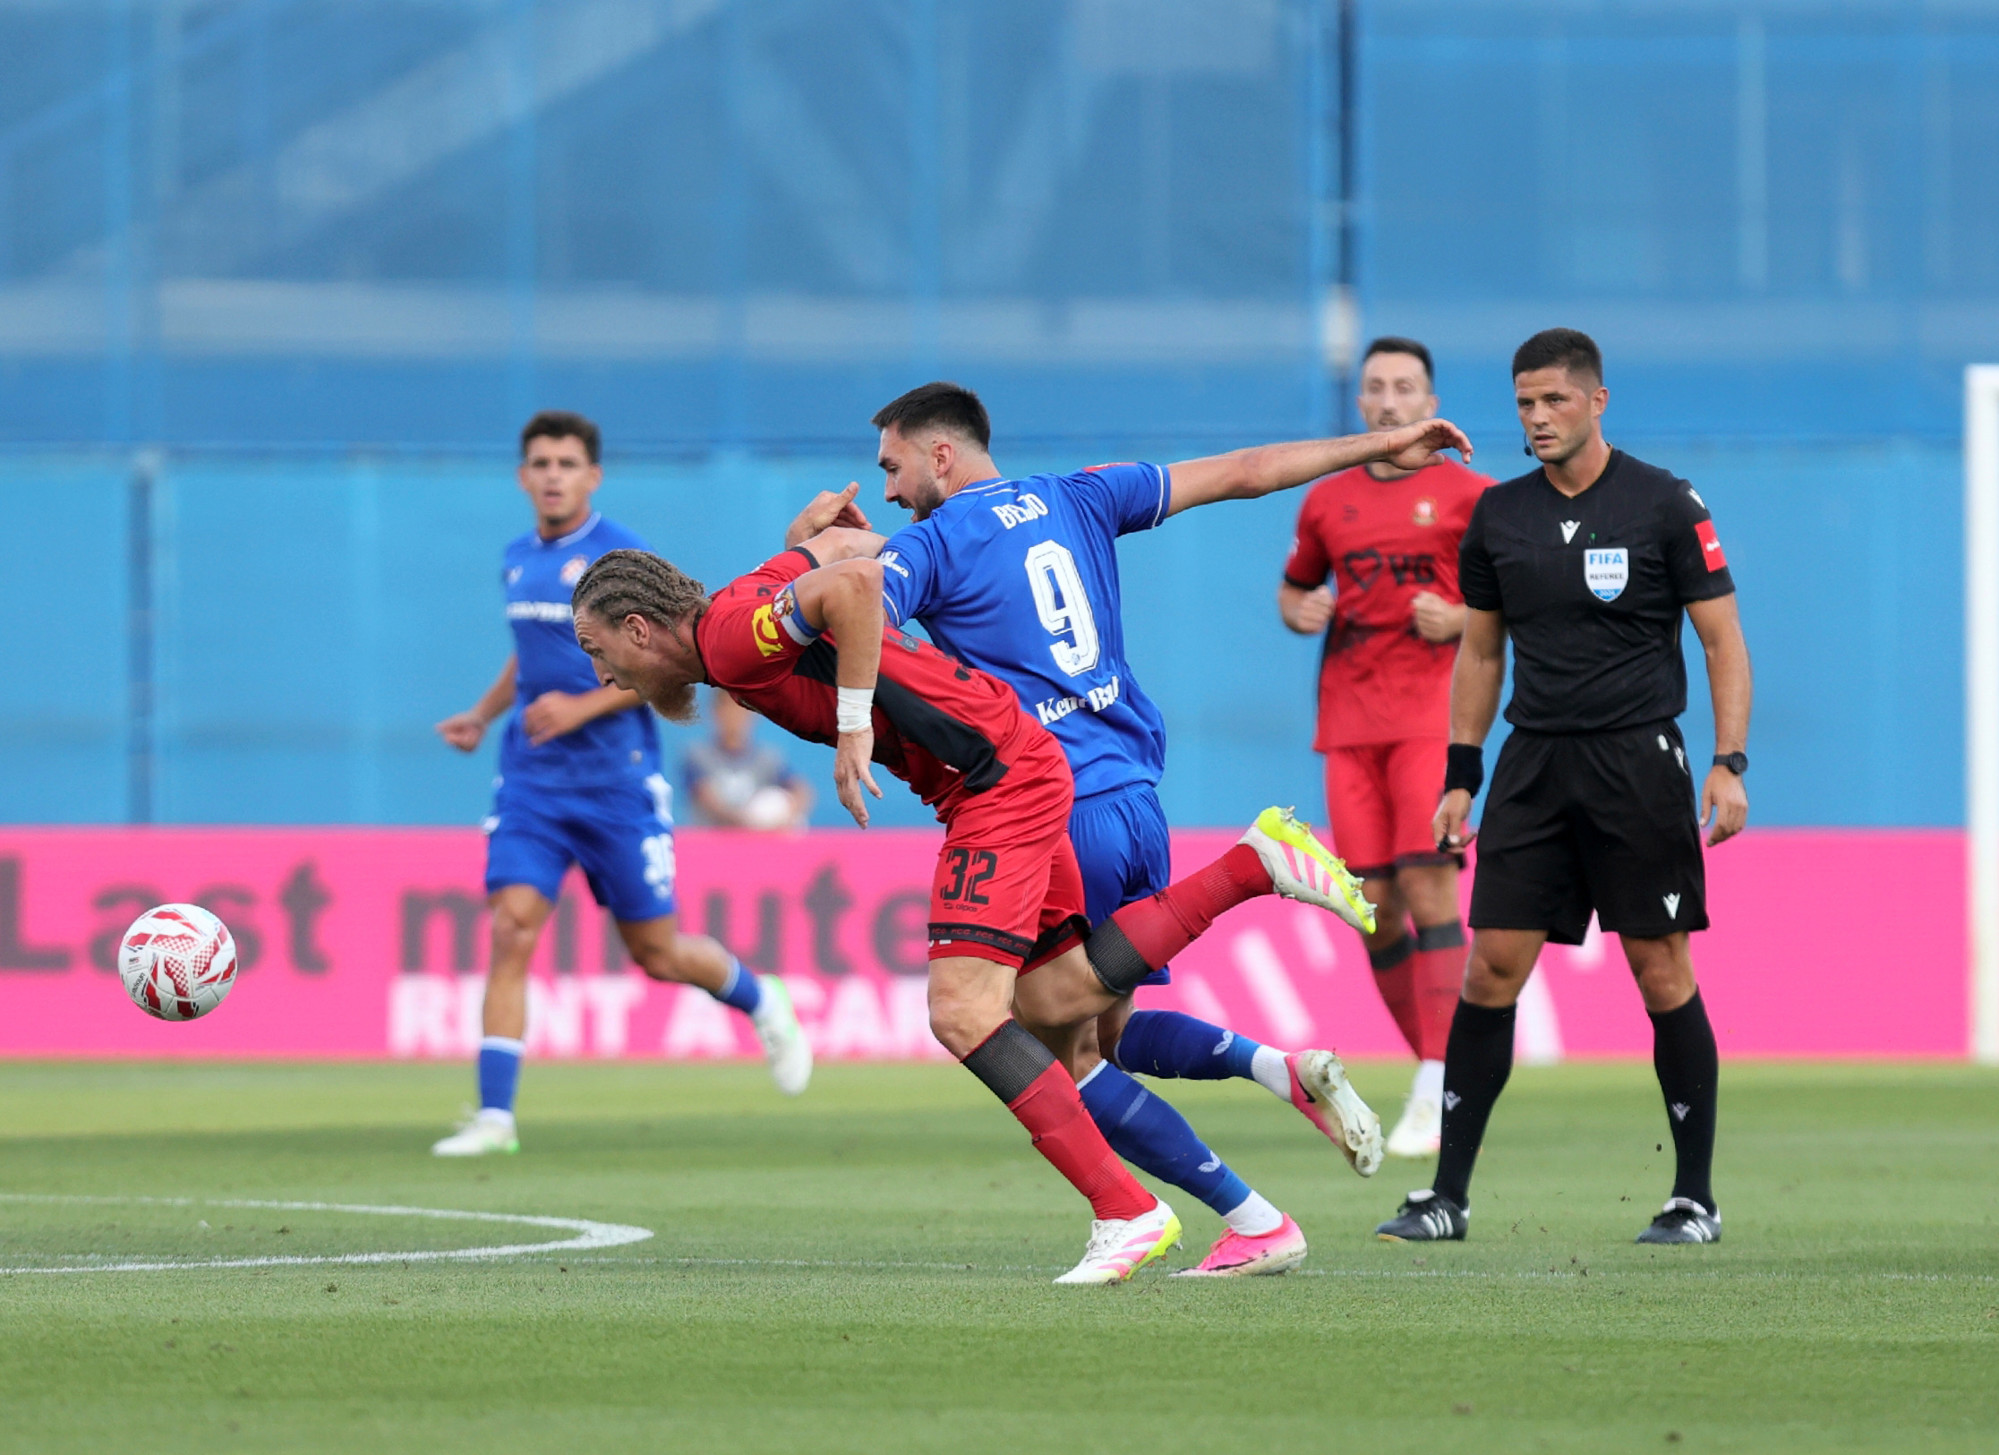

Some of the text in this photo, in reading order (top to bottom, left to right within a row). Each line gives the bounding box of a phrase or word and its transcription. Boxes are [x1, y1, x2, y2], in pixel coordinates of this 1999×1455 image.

[1589, 553, 1624, 565] FIFA
[1589, 572, 1624, 580] REFEREE
[1023, 539, 1100, 677] 9
[940, 848, 998, 905] 32
